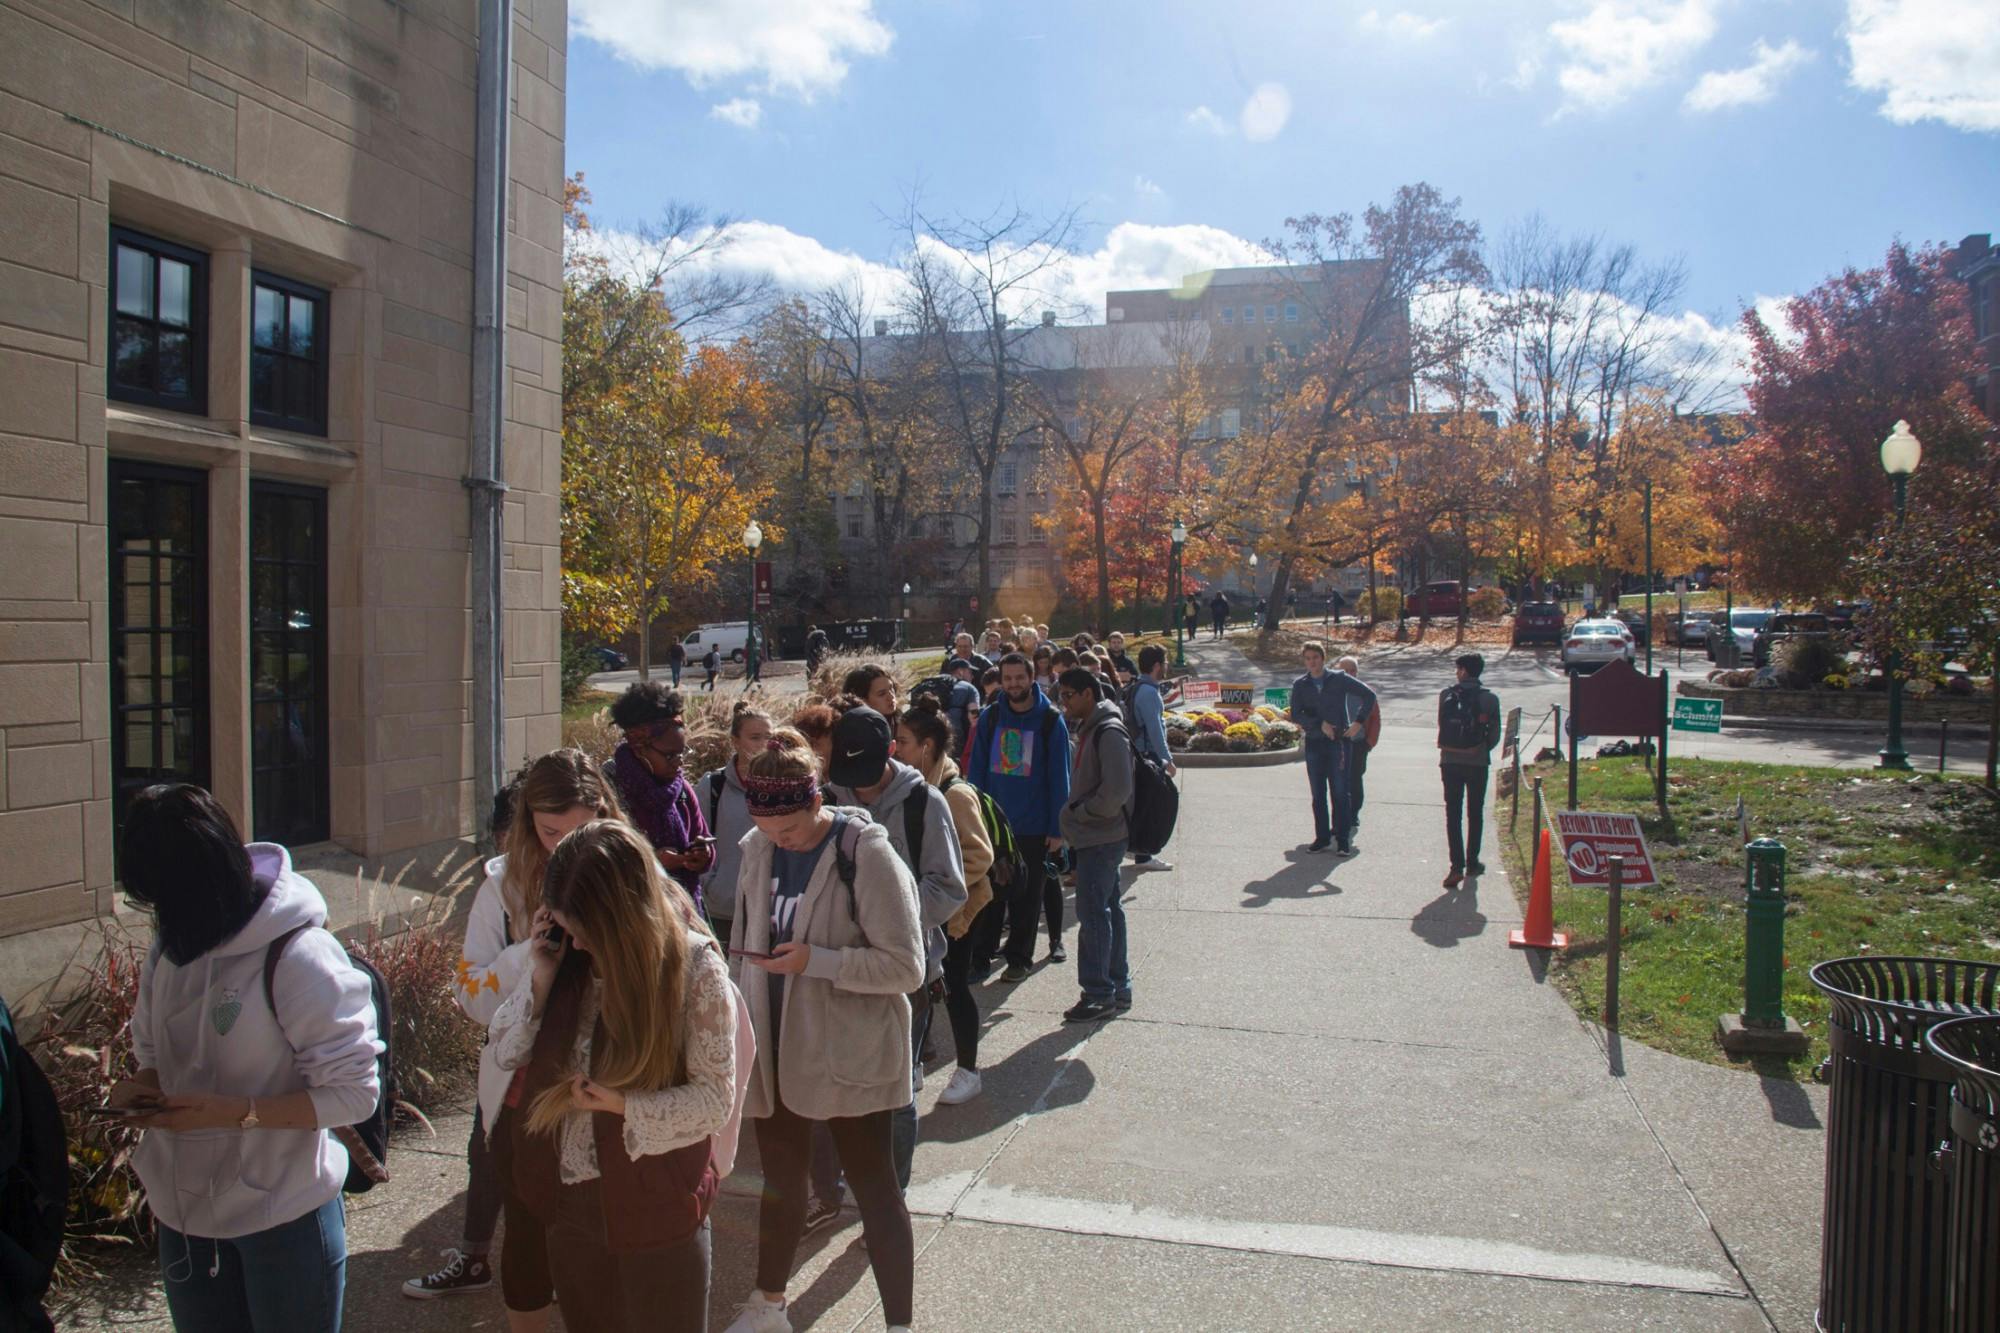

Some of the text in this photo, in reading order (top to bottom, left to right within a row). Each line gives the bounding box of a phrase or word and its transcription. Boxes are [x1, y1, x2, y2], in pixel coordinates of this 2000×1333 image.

[1222, 690, 1253, 704] AWSON
[1674, 710, 1720, 722] Schmitz
[1558, 815, 1637, 836] BEYOND THIS POINT
[1594, 841, 1638, 854] Campaigning
[1571, 847, 1595, 869] NO
